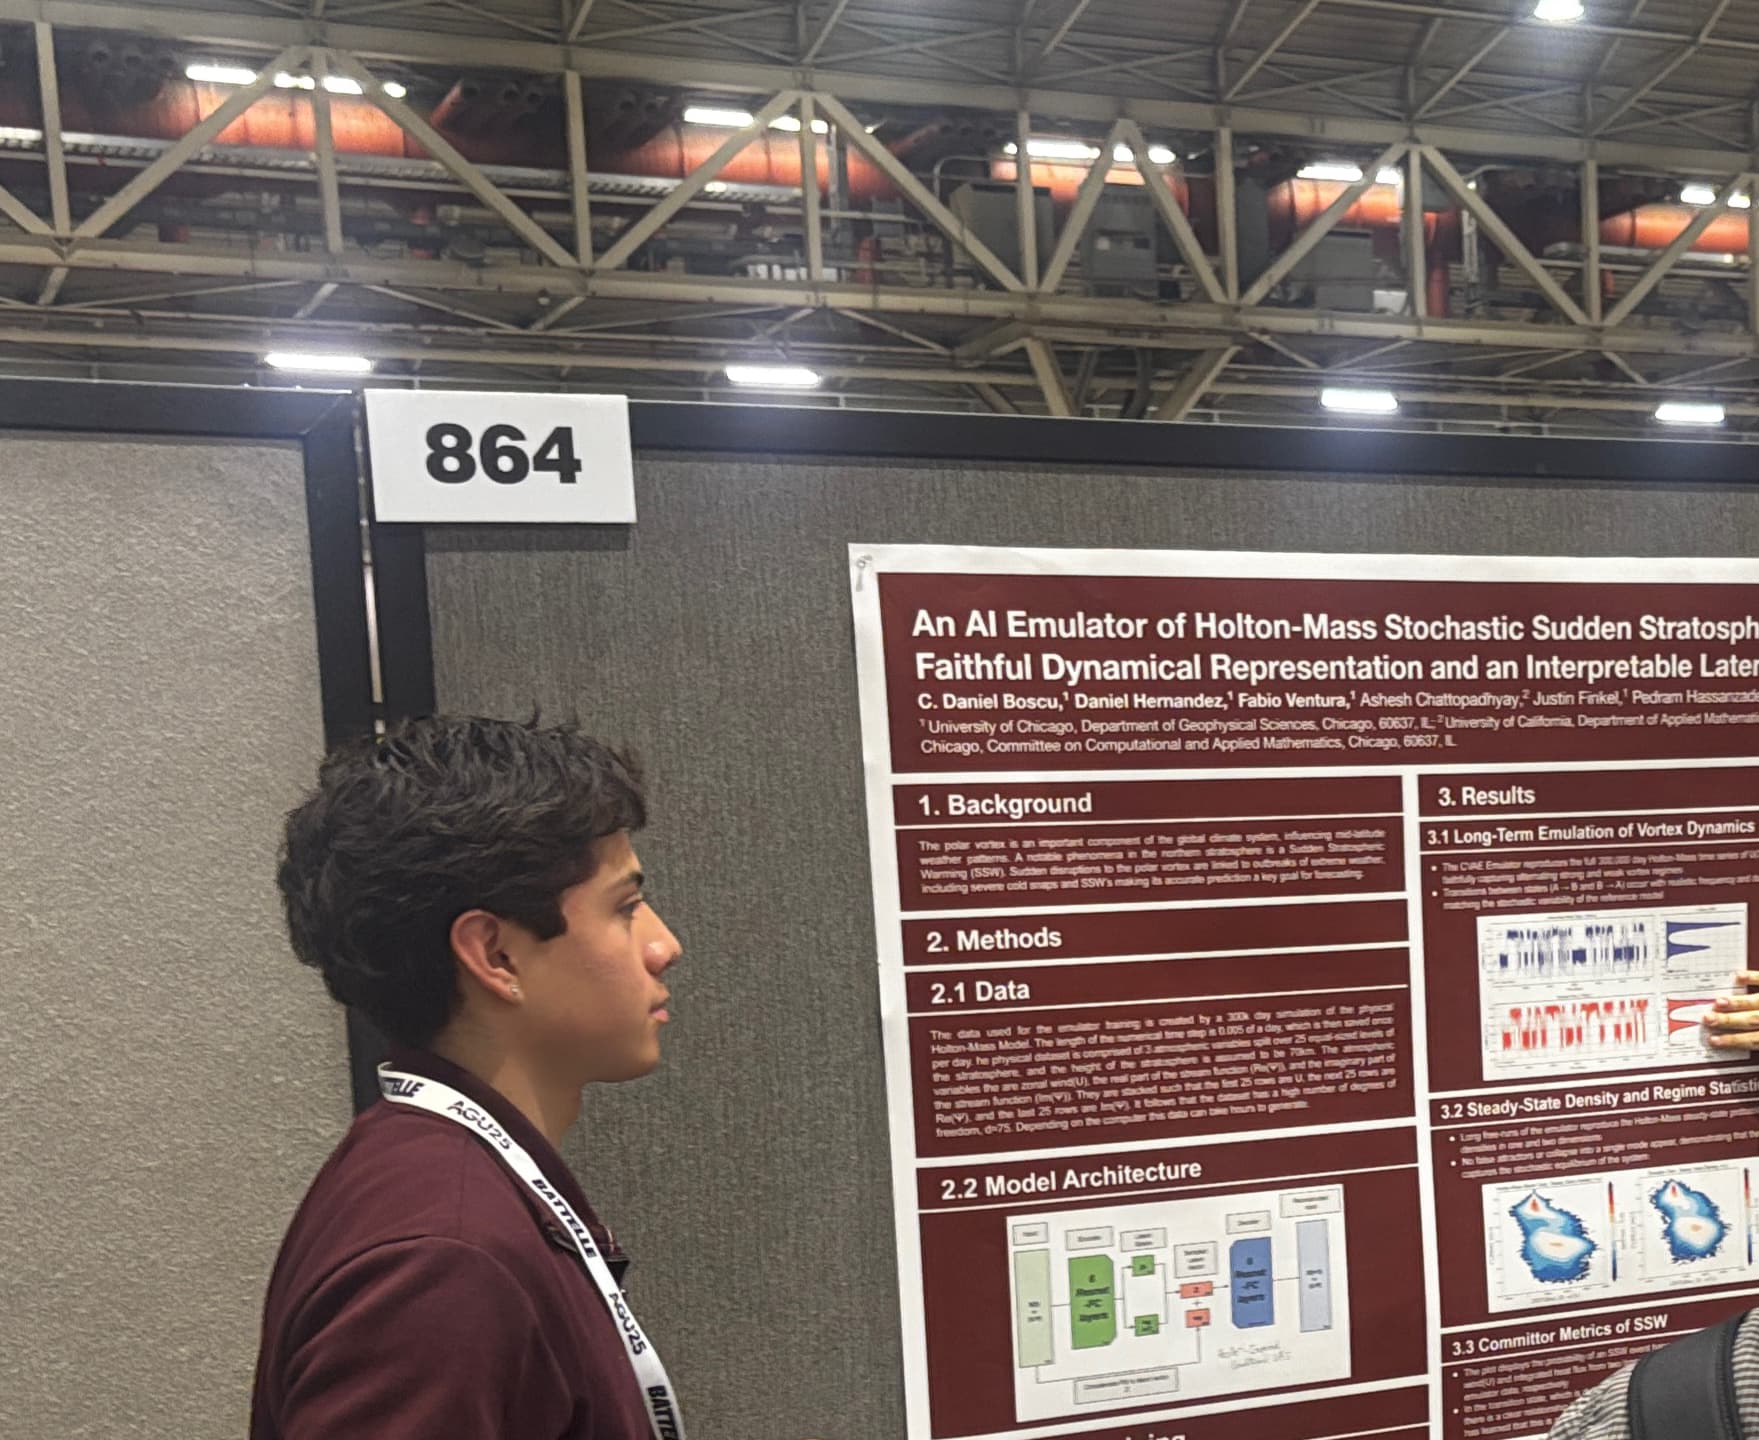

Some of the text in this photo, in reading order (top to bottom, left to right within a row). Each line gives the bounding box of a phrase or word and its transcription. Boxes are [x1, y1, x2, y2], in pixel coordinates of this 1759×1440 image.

[425, 422, 582, 484] 864
[912, 609, 955, 637] An
[965, 609, 997, 637] AI
[1007, 610, 1148, 639] Emulator
[1156, 612, 1187, 639] of
[1195, 612, 1378, 640] Holton-Mass
[1384, 613, 1524, 641] Stochastic
[1532, 614, 1633, 641] Sudden
[915, 652, 1032, 680] Faithful
[1041, 653, 1201, 686] Dynamical
[1210, 653, 1423, 686] Representation
[1430, 655, 1479, 680] and
[1486, 660, 1519, 680] an
[1526, 653, 1693, 684] Interpretable
[917, 694, 938, 709] C.
[943, 693, 998, 709] Daniel
[1075, 693, 1129, 709] Daniel
[1238, 692, 1282, 708] Fabio
[1360, 692, 1412, 707] Ashesh
[1532, 691, 1575, 706] Justin
[1632, 690, 1682, 704] Pedram
[928, 720, 996, 736] University
[1000, 720, 1014, 733] of
[1017, 721, 1078, 736] Chicago,
[1081, 719, 1159, 735] Department
[1162, 719, 1176, 732] of
[1178, 718, 1256, 735] Geophysical
[1503, 716, 1515, 729] of
[1578, 715, 1645, 729] Department
[1647, 714, 1659, 726] of
[1661, 713, 1701, 727] Applied
[921, 739, 983, 756] Chicago,
[987, 739, 1061, 753] Committee
[1064, 741, 1082, 752] on
[1085, 737, 1181, 754] Computational
[1184, 737, 1209, 750] and
[1212, 736, 1260, 752] Applied
[918, 792, 1093, 819] 1. Background
[1438, 785, 1536, 806] 3. Results
[1427, 818, 1756, 847] 3.1 Long-Term Emulation of Vortex Dynamics
[926, 927, 1063, 953] 2. Methods
[930, 980, 1031, 1004] 2.1 Data
[1440, 1104, 1463, 1120] 3.2
[1467, 1096, 1562, 1118] Steady-State
[1565, 1090, 1619, 1113] Density
[1622, 1089, 1651, 1106] and
[1653, 1083, 1706, 1104] Regime
[941, 1162, 1202, 1200] 2.2 Model Architecture
[446, 1100, 512, 1150] AGU25
[531, 1178, 597, 1259] BATTELLE
[608, 1292, 647, 1356] AGU25
[1451, 1314, 1669, 1357] 3.3 Committor Metrics of SSW
